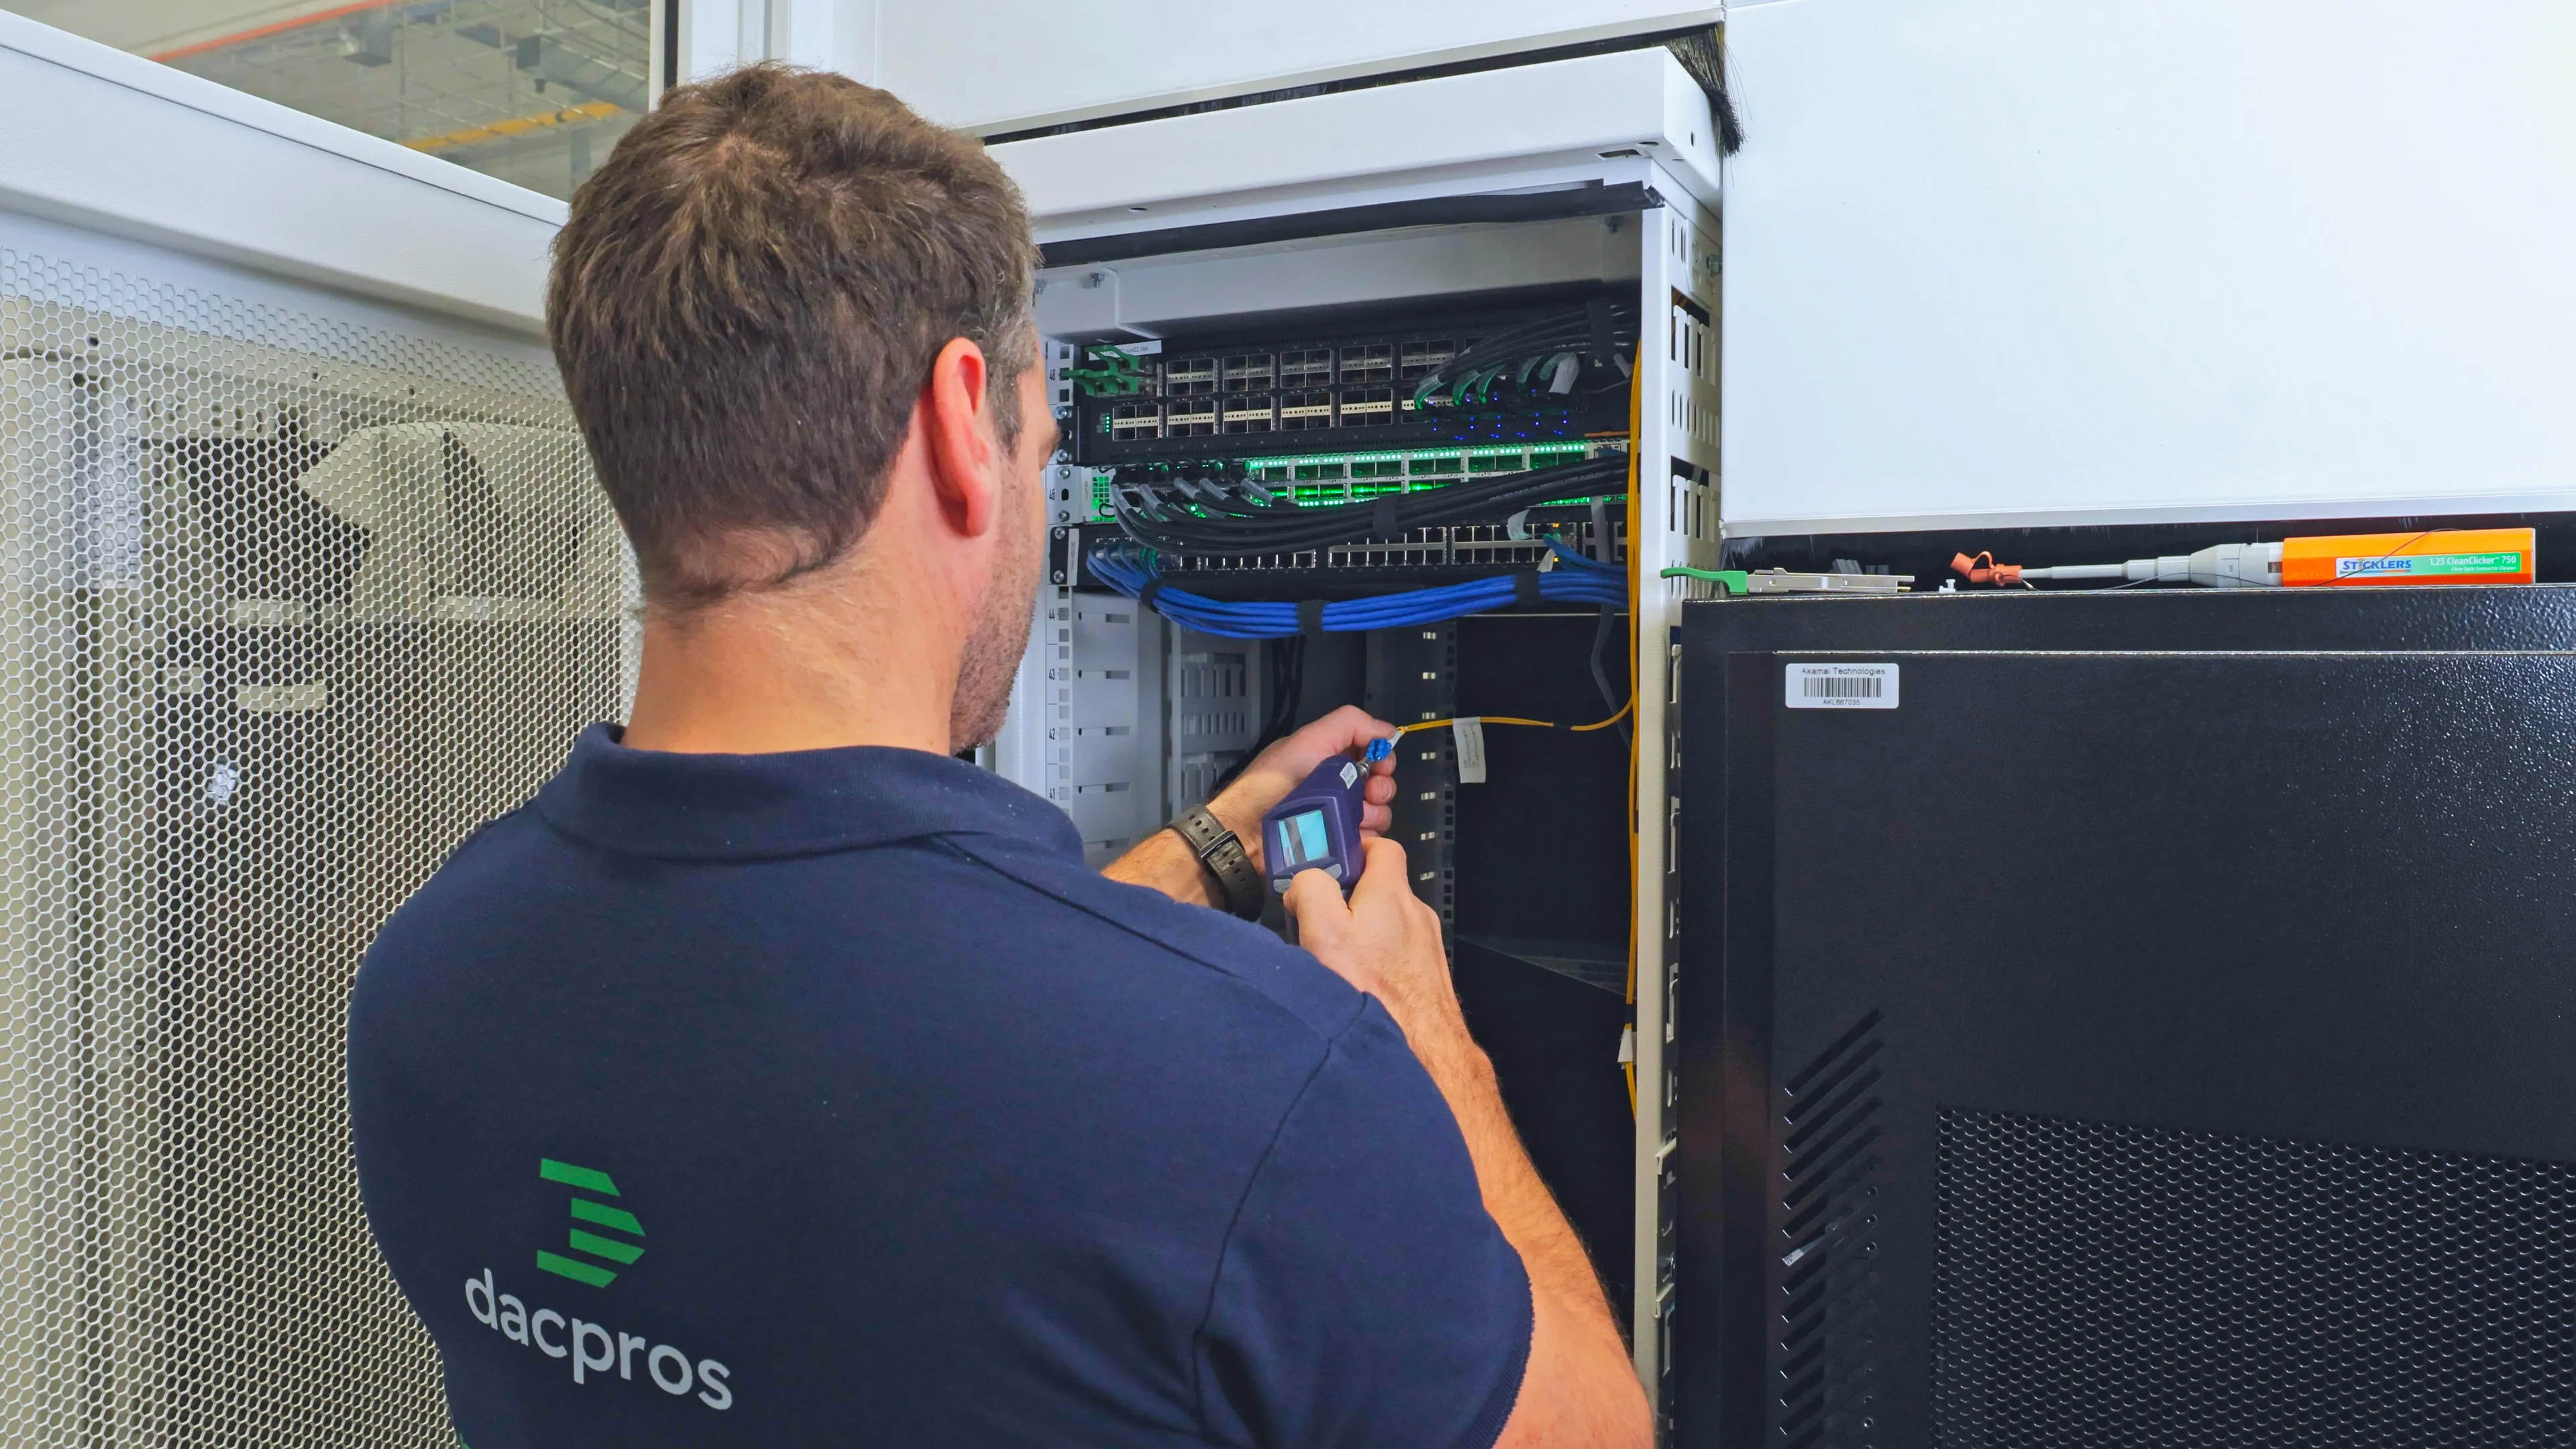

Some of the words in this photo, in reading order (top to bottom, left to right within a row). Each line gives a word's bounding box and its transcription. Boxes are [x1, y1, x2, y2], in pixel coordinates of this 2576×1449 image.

[1049, 368, 1056, 381] 48
[1049, 488, 1055, 500] 46
[2343, 558, 2412, 570] STICKLERS
[2429, 557, 2445, 566] 1.25
[2501, 555, 2517, 564] 750
[1049, 608, 1055, 621] 44
[1049, 669, 1055, 681] 43
[1833, 667, 1886, 676] Technologies
[1049, 729, 1056, 741] 42
[1049, 788, 1056, 800] 41
[464, 1267, 733, 1411] dacpros
